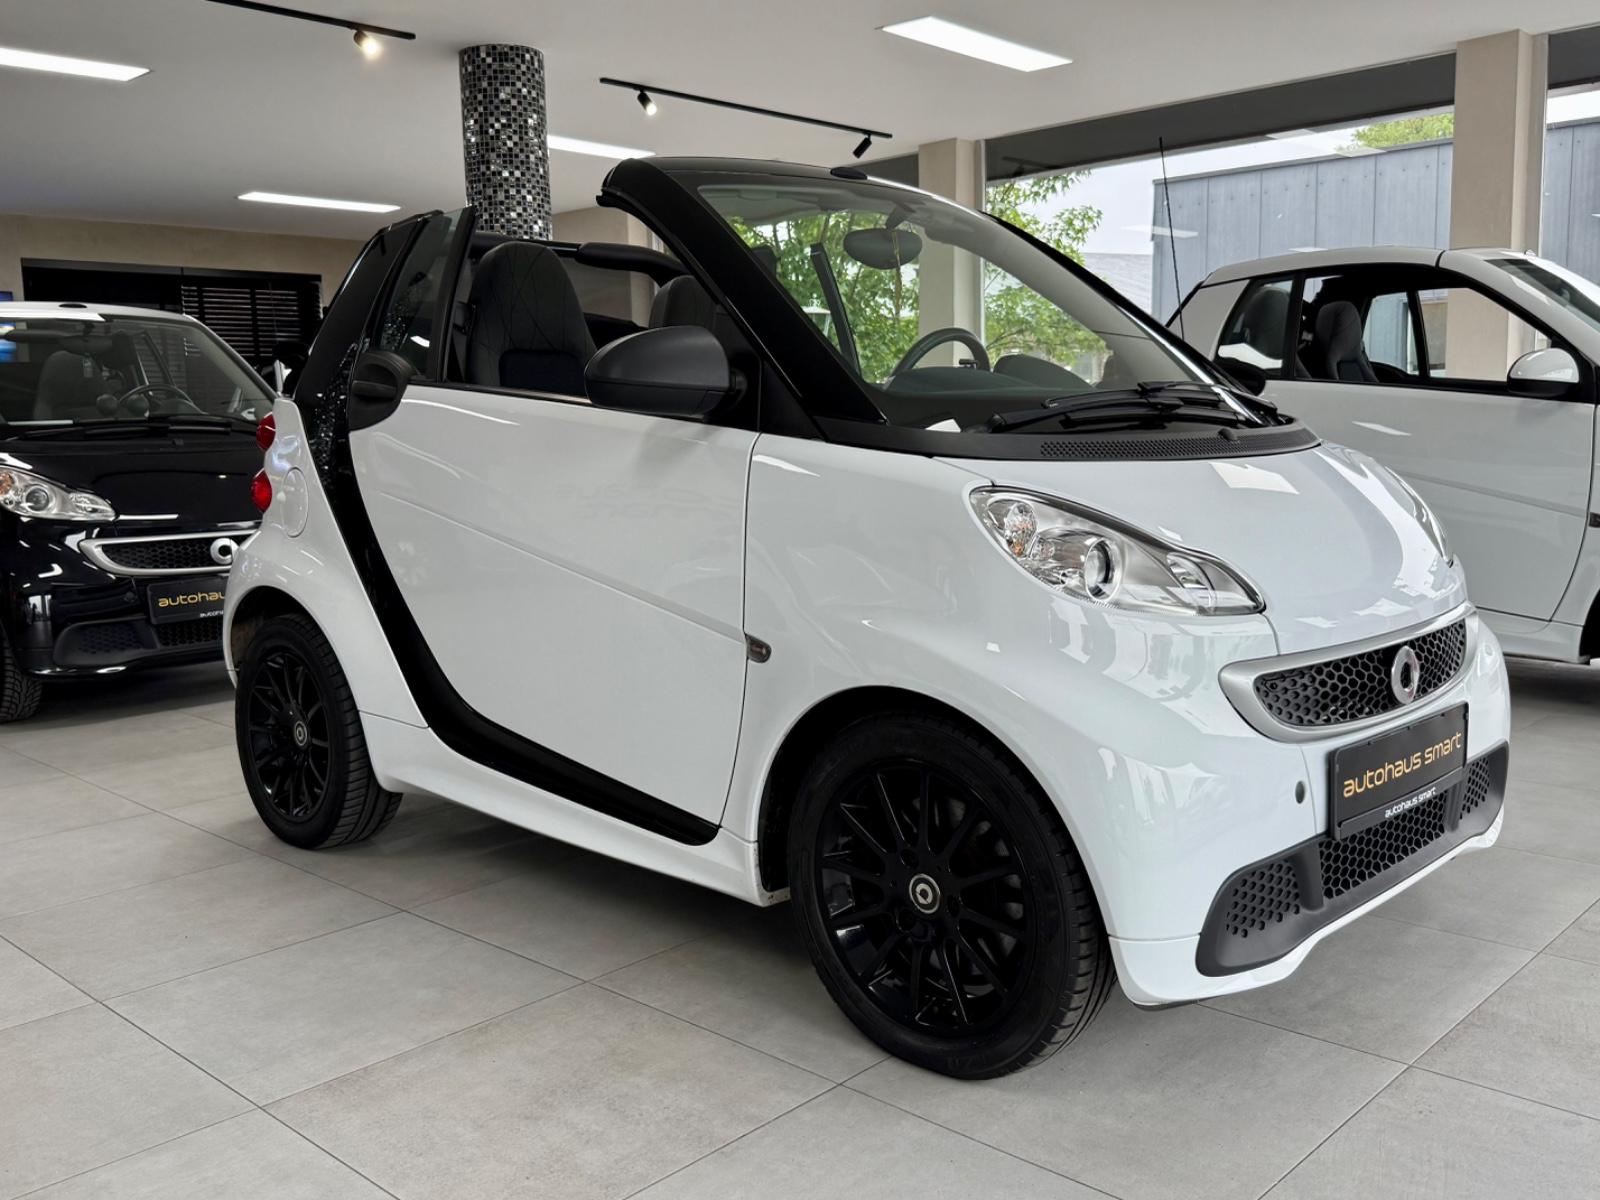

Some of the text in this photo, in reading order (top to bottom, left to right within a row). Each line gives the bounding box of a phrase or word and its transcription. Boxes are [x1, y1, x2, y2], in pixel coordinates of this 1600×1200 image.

[158, 591, 225, 607] autohau
[1343, 731, 1462, 798] autohaus smart
[1385, 786, 1436, 818] autohaus smart
